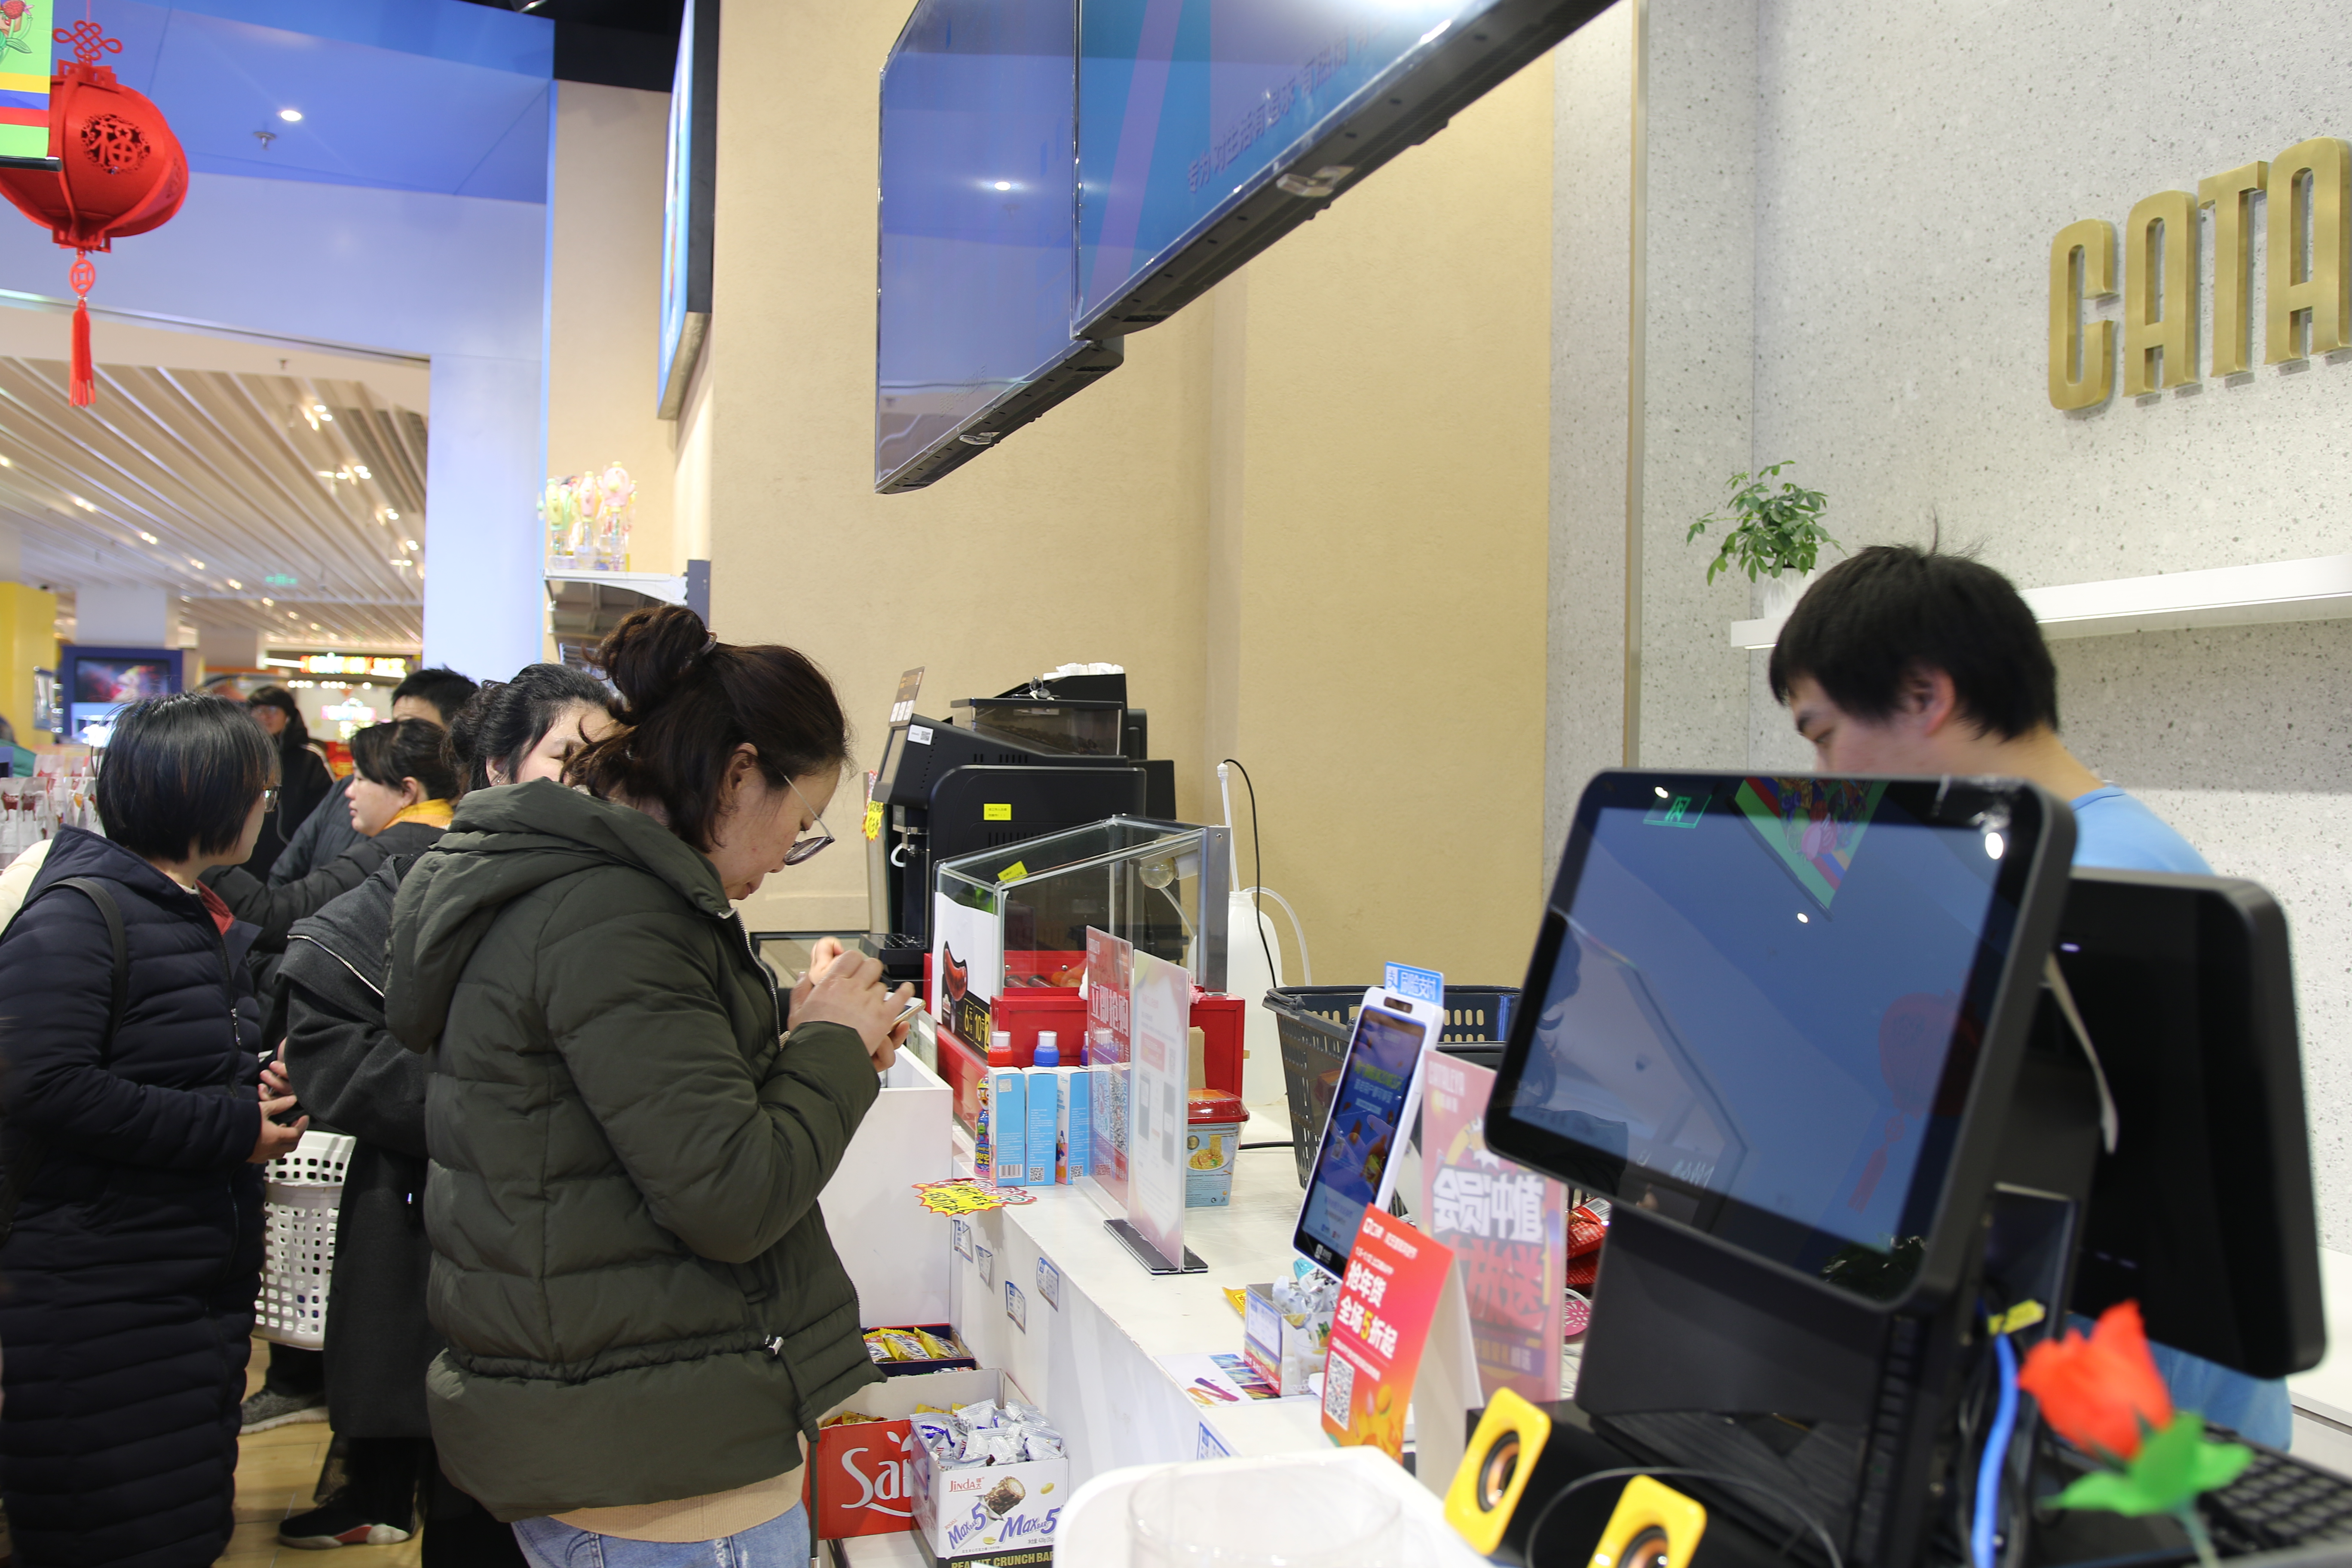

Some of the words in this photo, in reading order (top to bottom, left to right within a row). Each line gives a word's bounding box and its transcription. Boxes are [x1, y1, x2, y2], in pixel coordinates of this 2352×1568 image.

[2048, 137, 2352, 410] CATA
[1433, 1167, 1544, 1243] 会员冲值
[998, 1514, 1038, 1542] Max
[1041, 1507, 1060, 1534] 5
[993, 1553, 1035, 1567] CRUNCH
